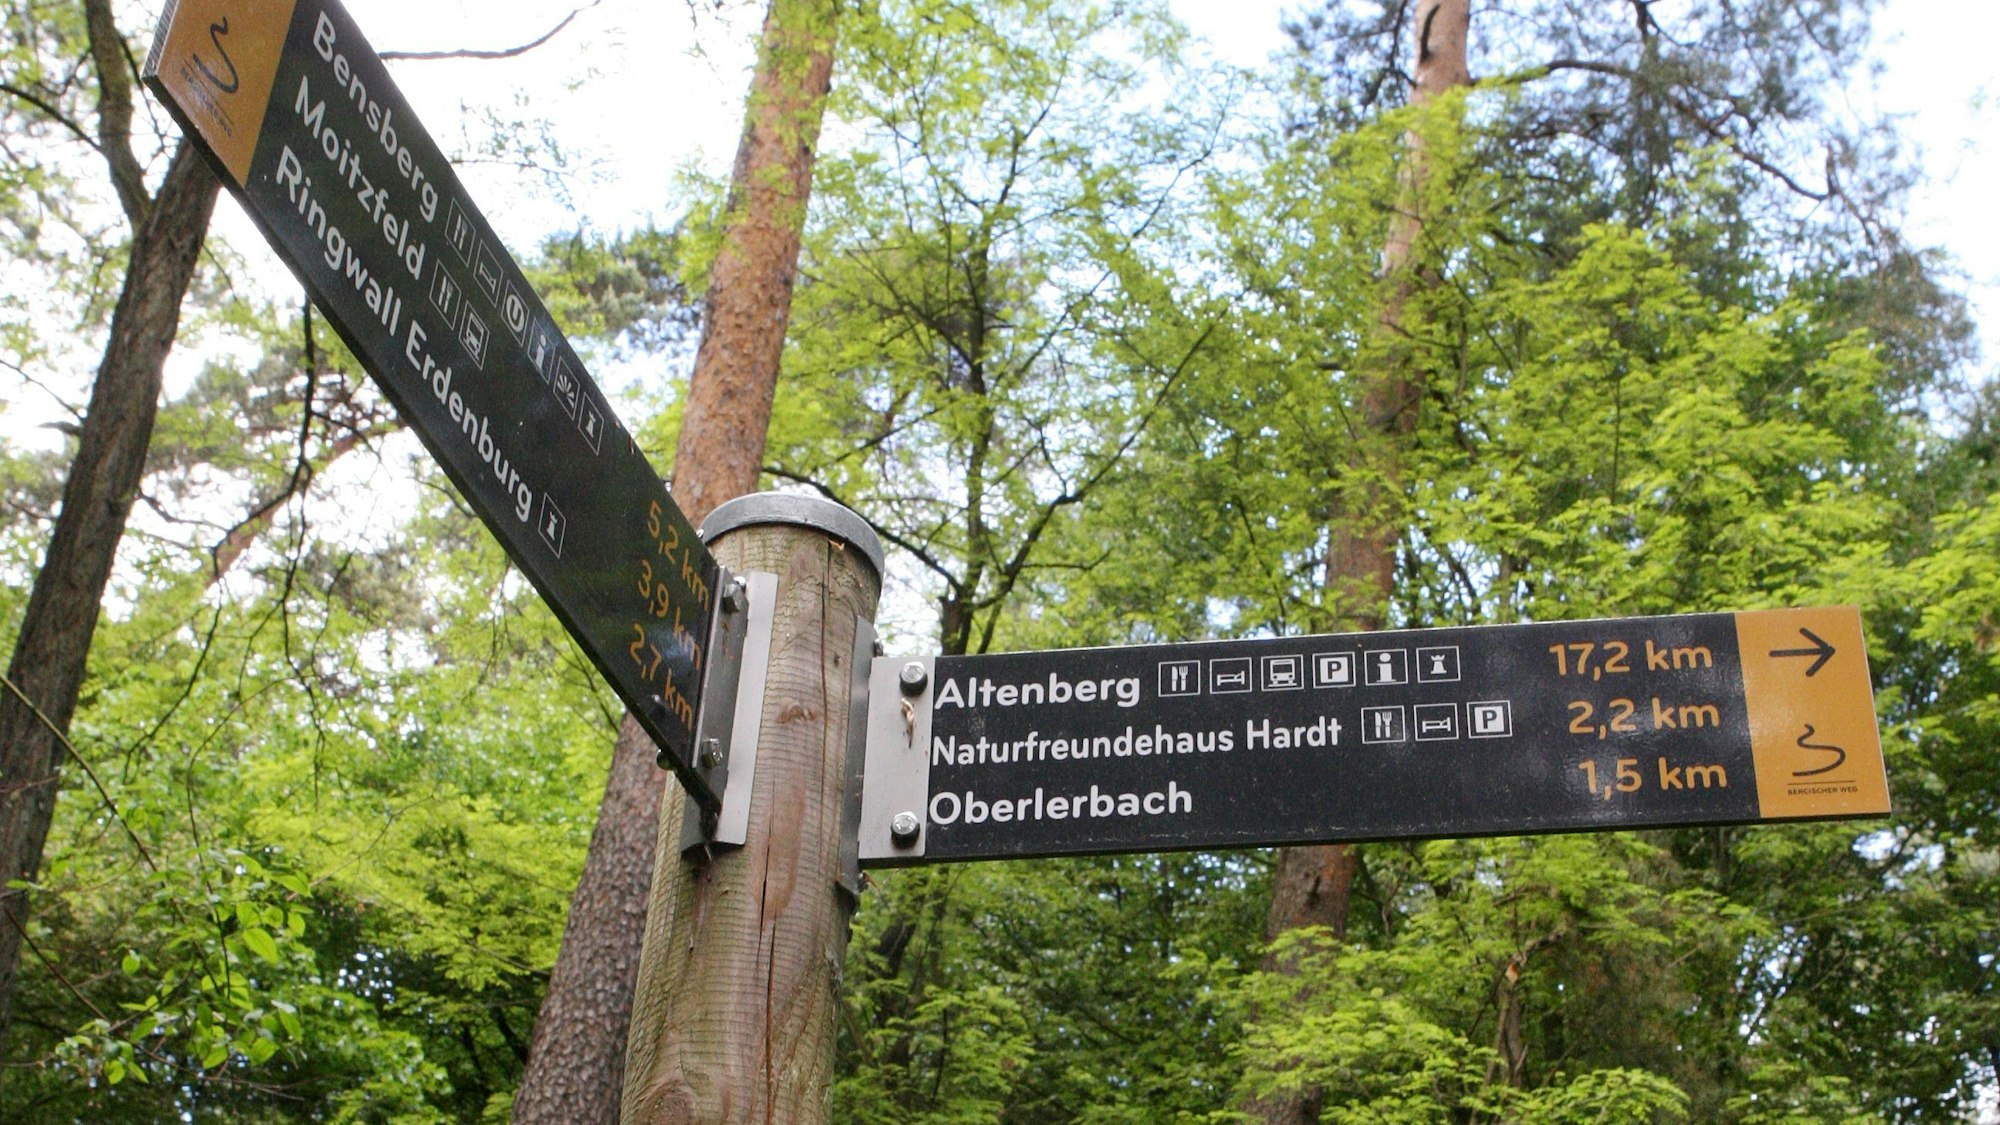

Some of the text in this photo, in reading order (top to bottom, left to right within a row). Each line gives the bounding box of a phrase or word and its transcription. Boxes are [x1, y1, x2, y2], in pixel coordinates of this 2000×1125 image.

[313, 10, 710, 612] Bensberg 5,2 km
[295, 75, 701, 671] Moitzfeld 3,9 km
[276, 144, 693, 731] Ringwall Erdenburg 2,7 km
[934, 672, 1141, 709] Altenberg
[1549, 641, 1631, 682] 17,2
[1646, 640, 1713, 672] km
[932, 724, 1235, 767] Naturfreundehaus
[1246, 716, 1342, 750] Hardt
[1567, 699, 1637, 740] 2,2
[1652, 697, 1720, 731] km
[929, 757, 1728, 825] Oberlerbach 1,5 km
[1840, 785, 1858, 793] WEG
